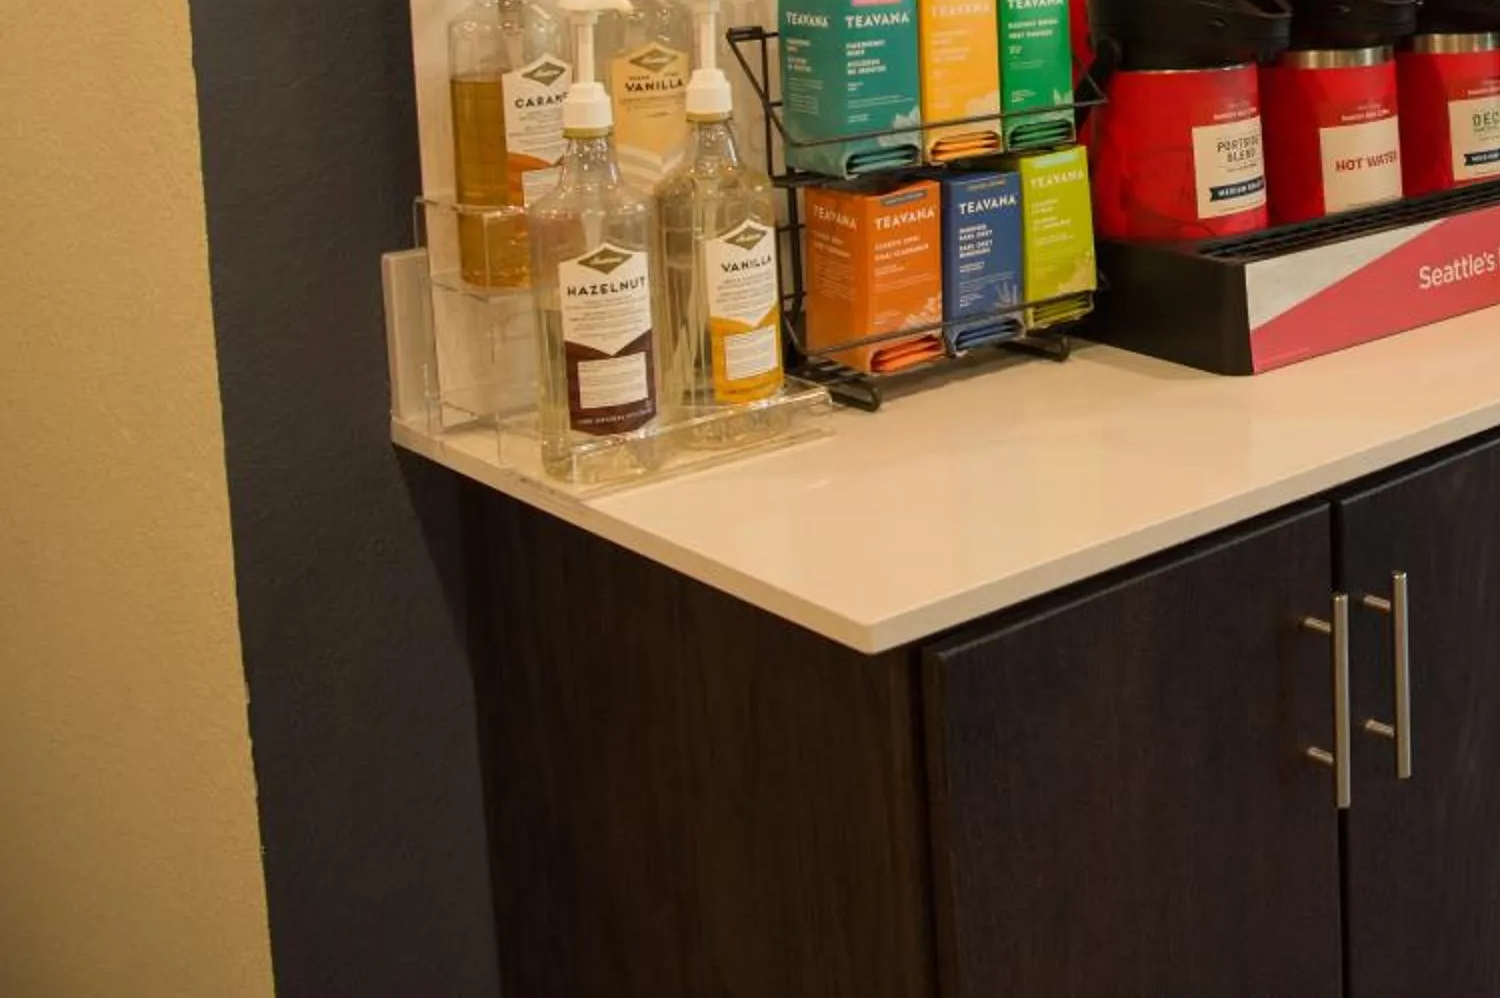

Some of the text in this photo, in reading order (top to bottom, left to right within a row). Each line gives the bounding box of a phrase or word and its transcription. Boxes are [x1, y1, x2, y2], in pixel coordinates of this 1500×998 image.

[845, 11, 910, 28] TEAVANA
[625, 78, 683, 92] VANILLA
[1335, 158, 1363, 172] HOT
[959, 194, 1017, 215] TEAVANA
[875, 206, 935, 230] TEAVANA
[721, 254, 772, 273] VANILLA
[1419, 253, 1496, 289] Seattle's
[567, 276, 645, 297] HAZELNUT
